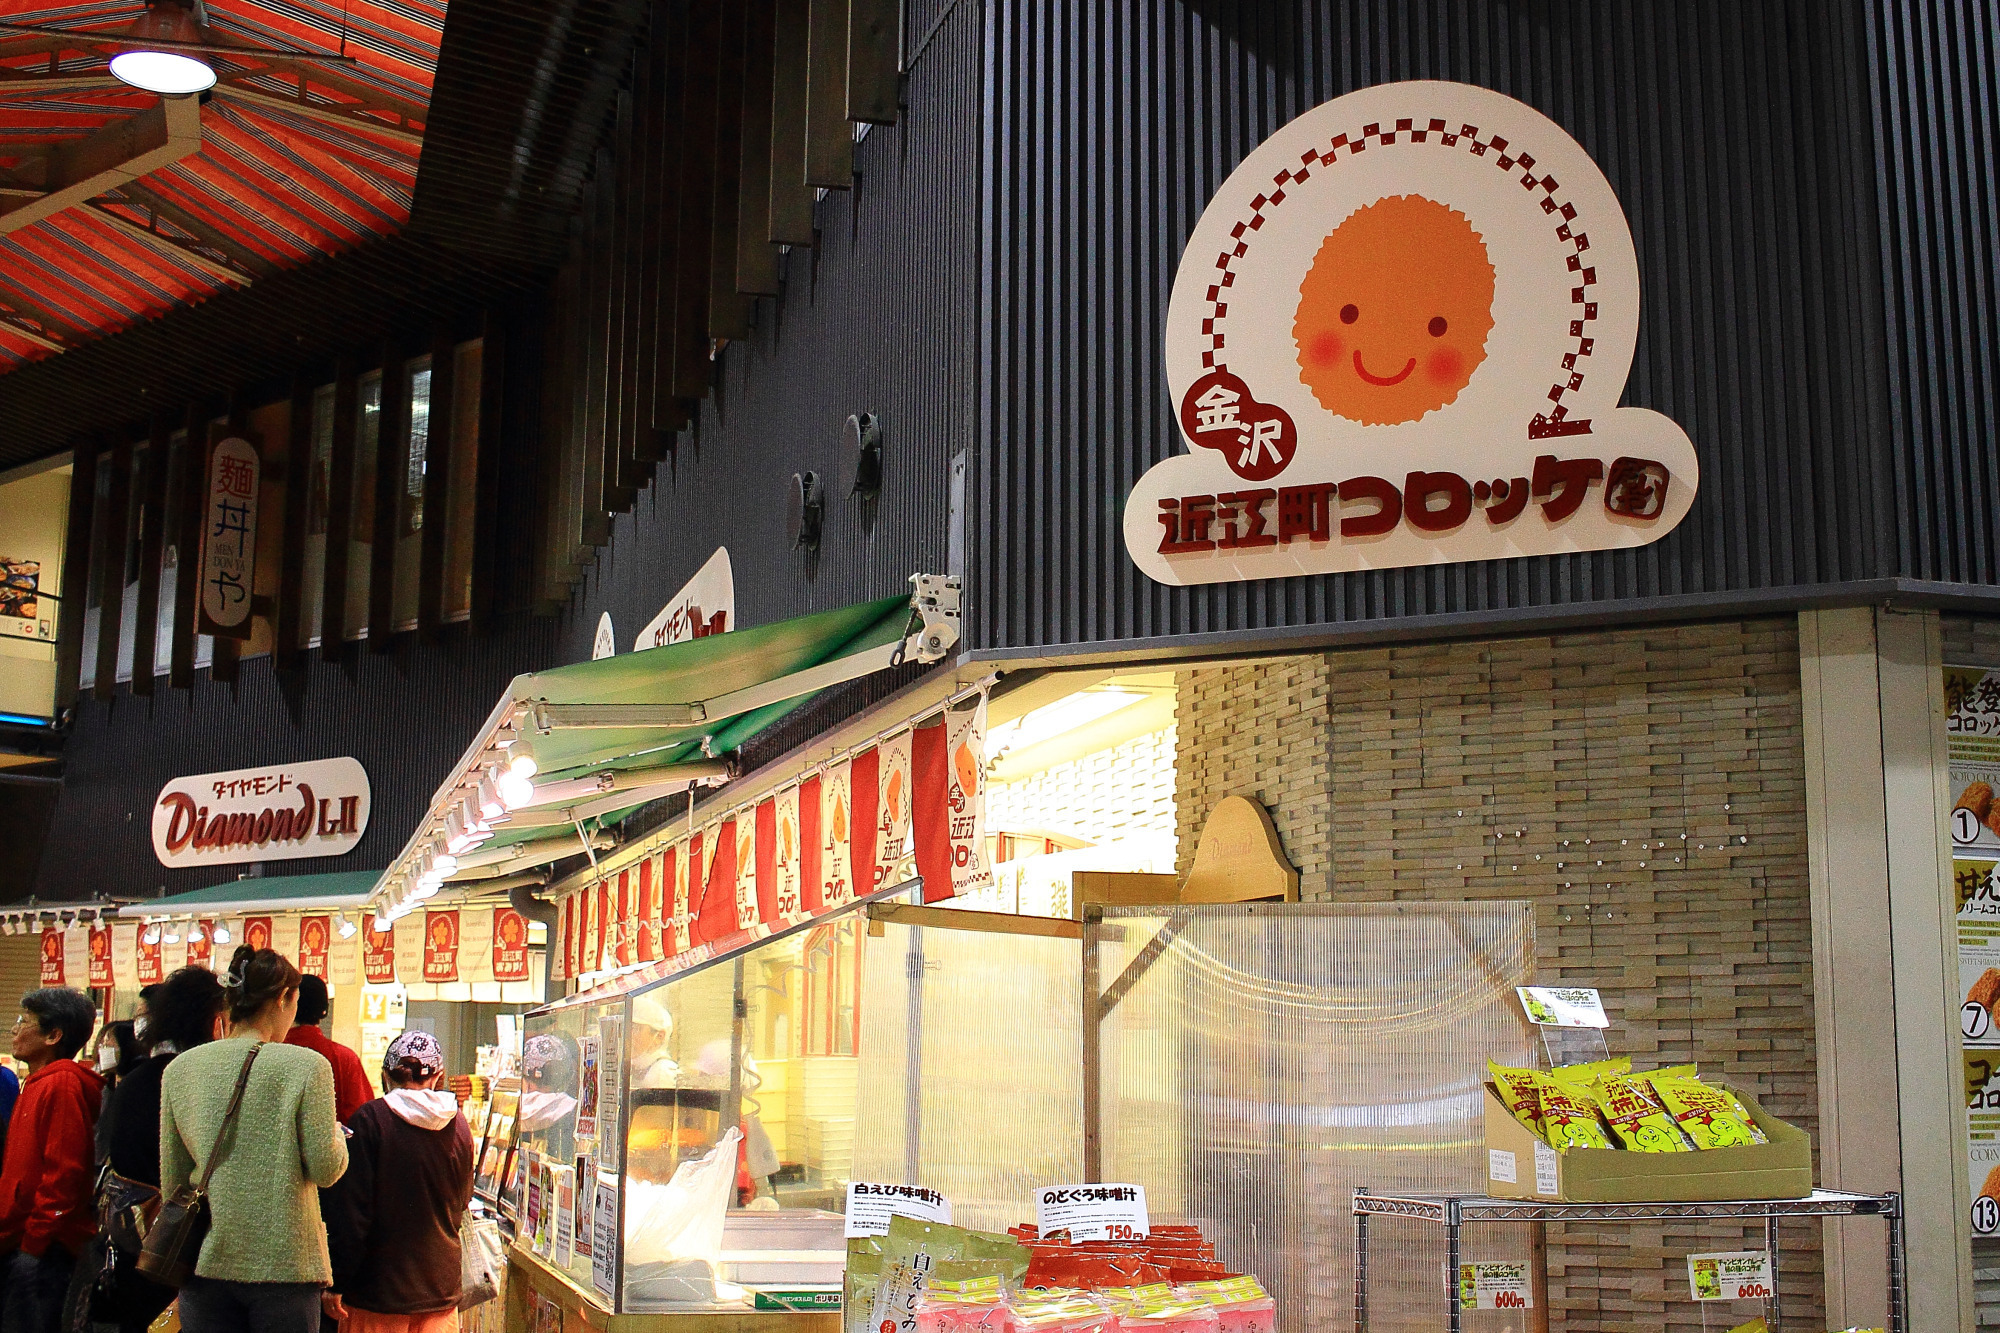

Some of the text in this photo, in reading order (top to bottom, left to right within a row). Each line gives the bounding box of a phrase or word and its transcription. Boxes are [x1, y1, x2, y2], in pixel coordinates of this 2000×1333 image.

[1195, 384, 1282, 468] 金沢
[212, 774, 293, 799] ダイヤモンド
[160, 783, 316, 850] Diamond
[1956, 811, 1968, 839] 1
[1955, 868, 2000, 902] 甘え
[1966, 1005, 1982, 1034] 7
[1976, 1199, 1996, 1229] 13
